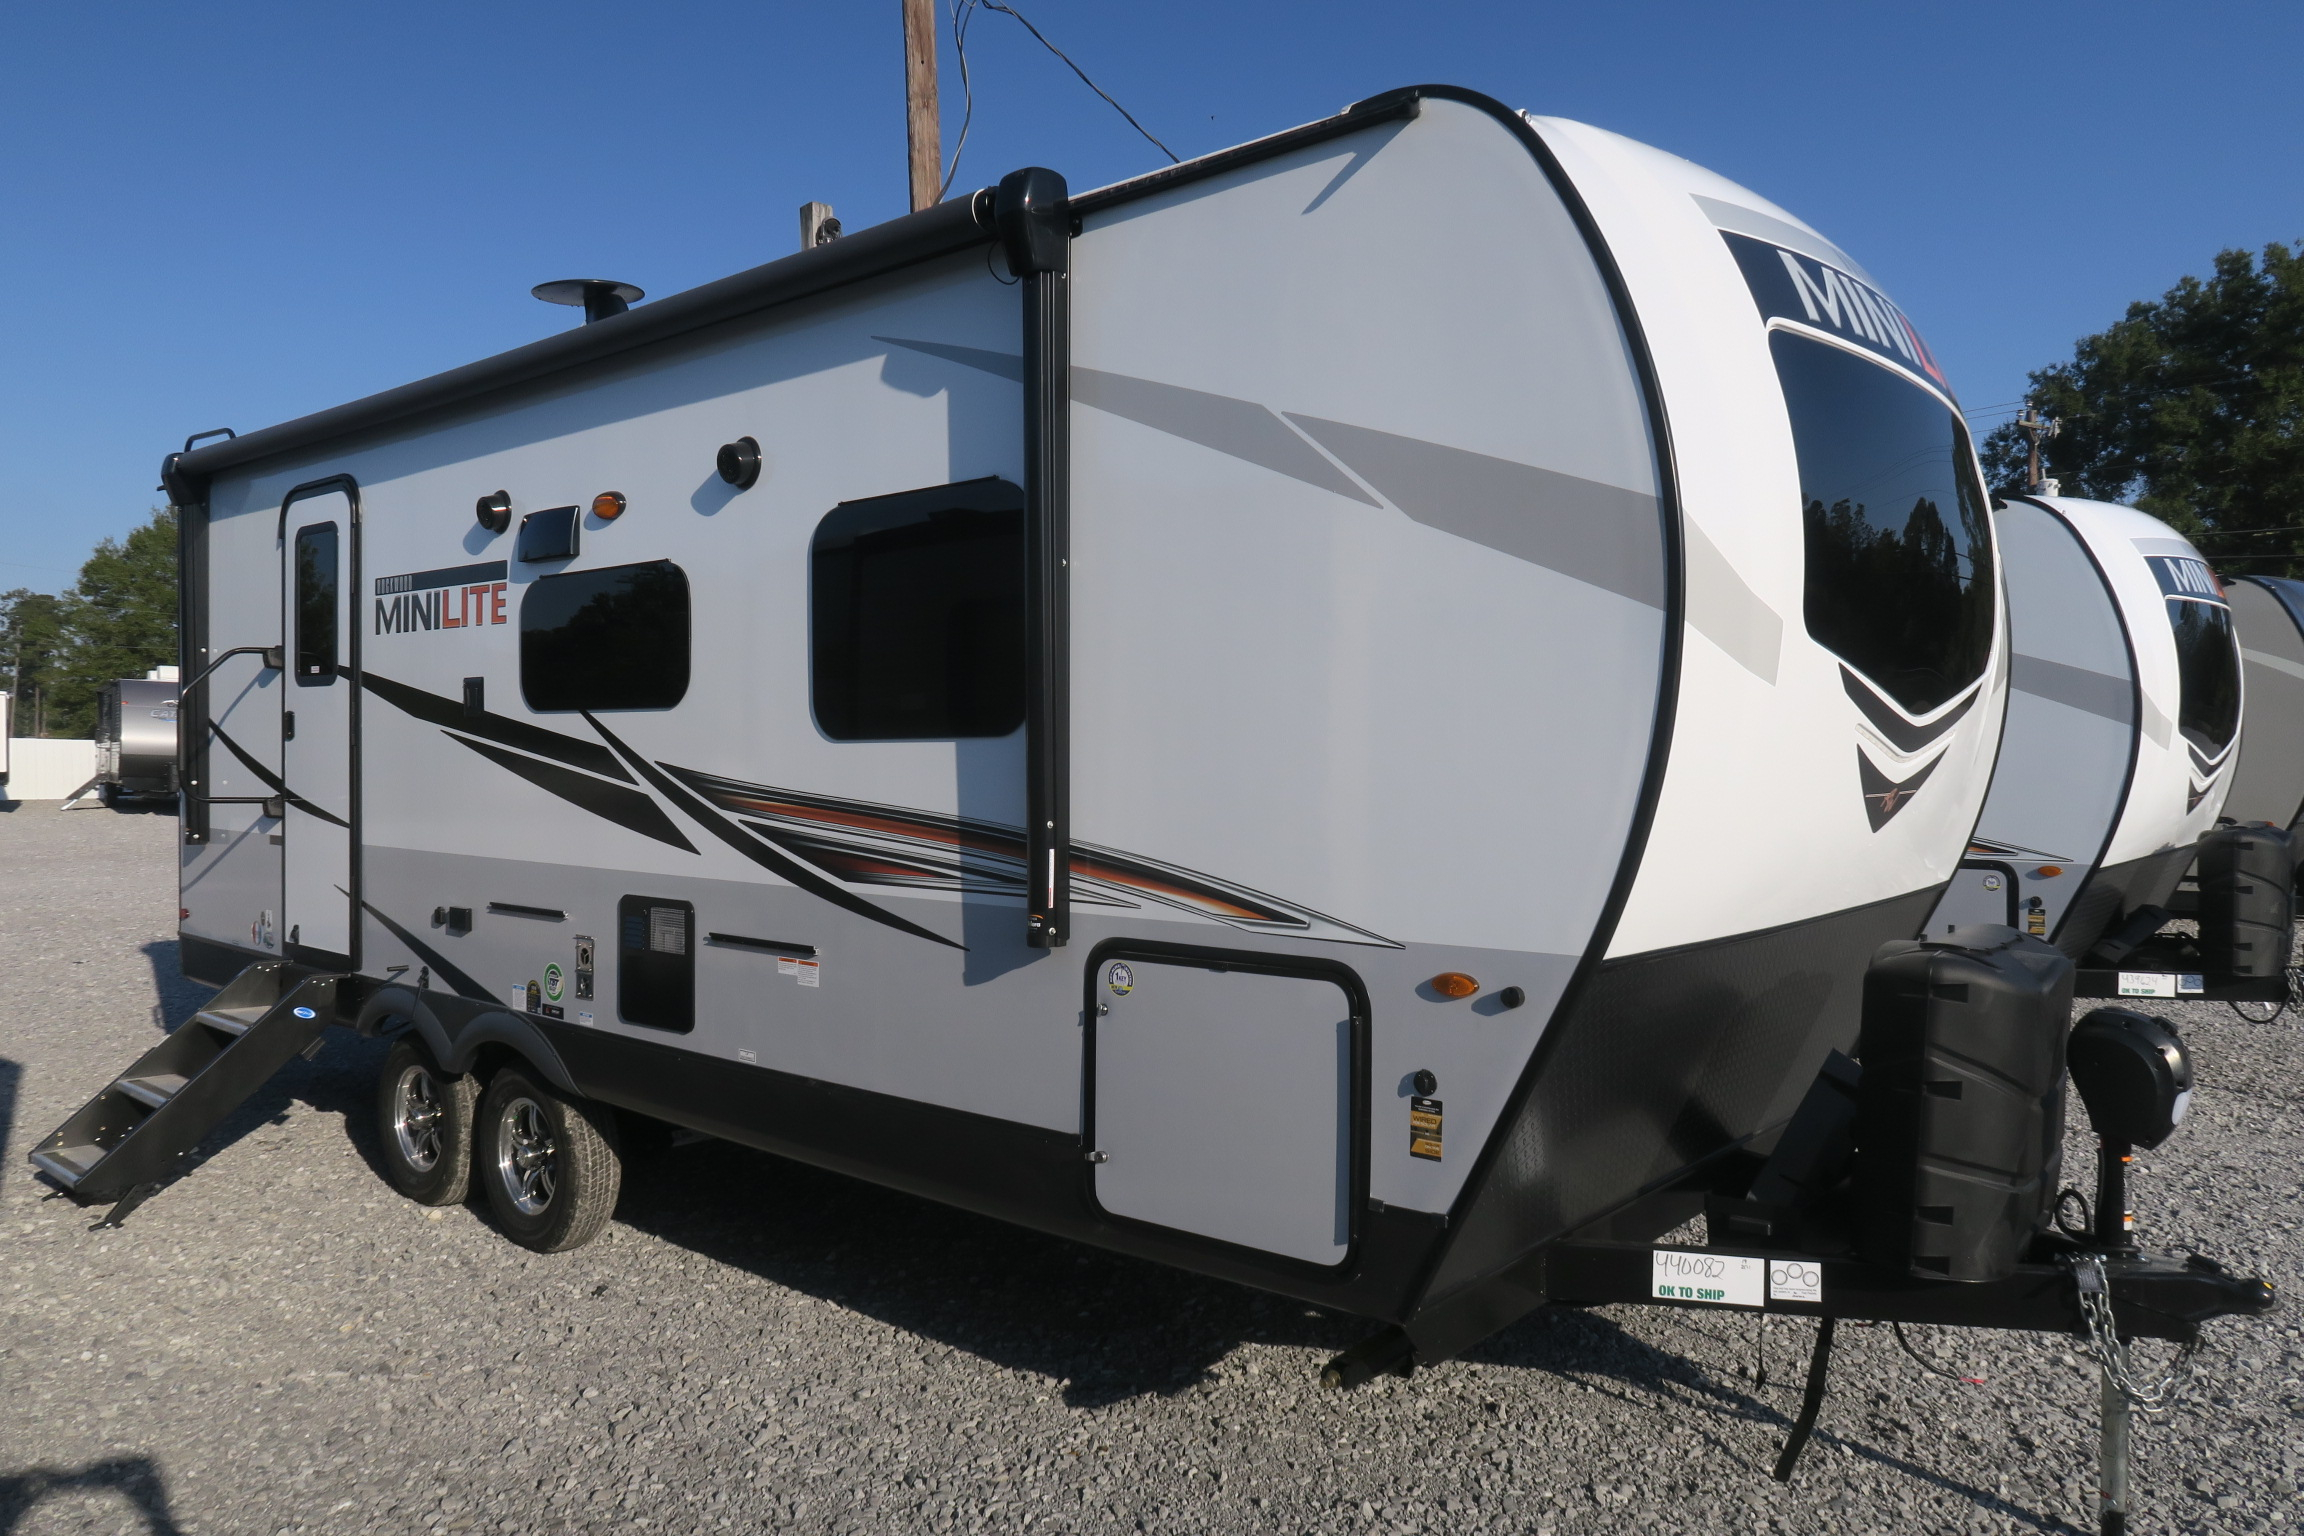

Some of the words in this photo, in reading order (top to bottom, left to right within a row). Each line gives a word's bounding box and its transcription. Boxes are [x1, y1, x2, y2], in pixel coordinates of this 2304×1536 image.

[375, 582, 507, 635] MINILITE
[1413, 1115, 1437, 1124] WIRED
[1655, 1252, 1726, 1280] 440082
[1658, 1284, 1675, 1297] OK
[1678, 1286, 1693, 1298] TO
[1696, 1288, 1725, 1300] SHIP
